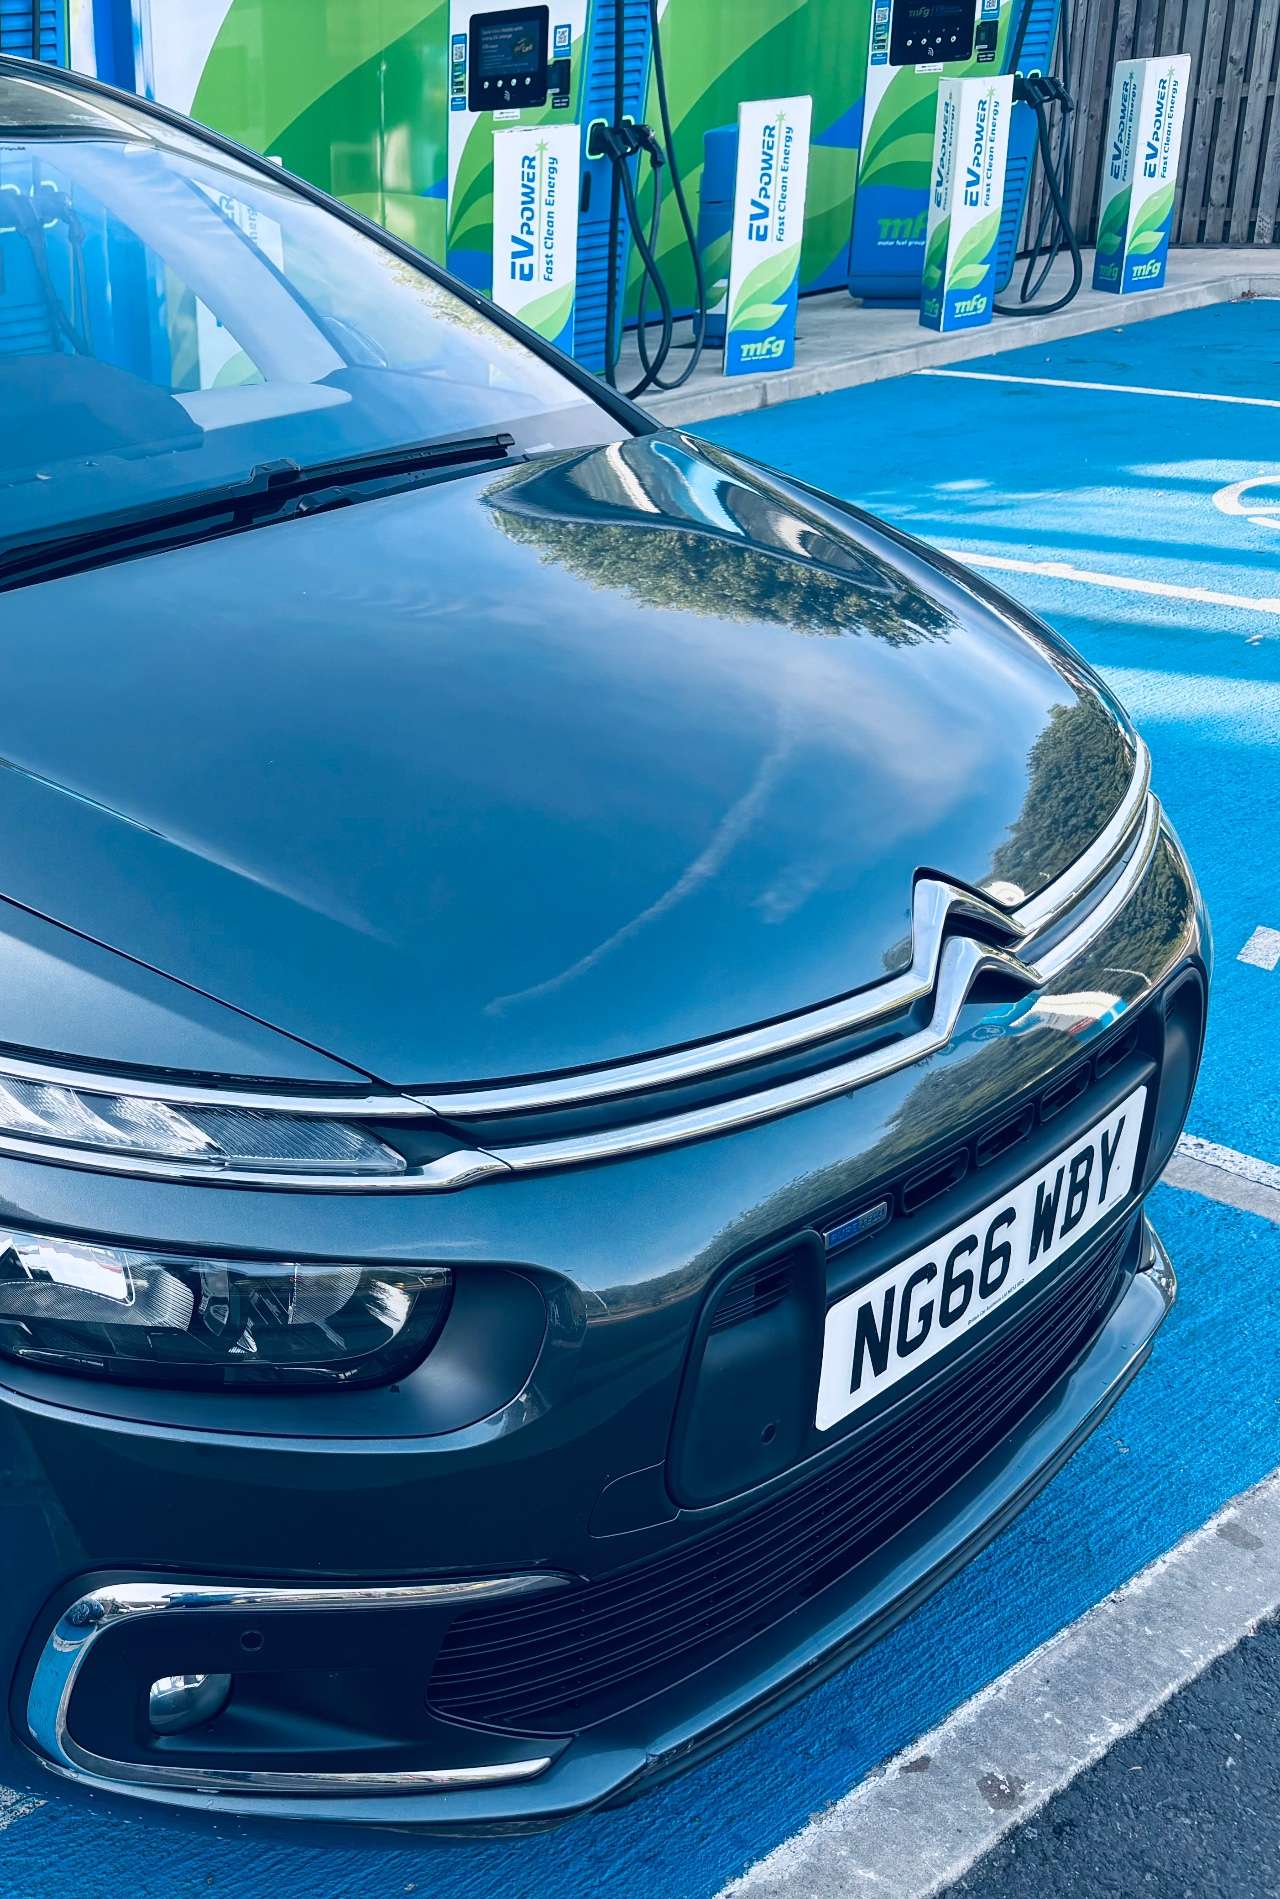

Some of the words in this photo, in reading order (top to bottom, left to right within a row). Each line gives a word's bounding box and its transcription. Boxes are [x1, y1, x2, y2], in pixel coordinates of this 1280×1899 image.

[1167, 80, 1179, 119] Energy
[988, 100, 1000, 142] Energy
[780, 126, 794, 172] Energy
[1163, 122, 1172, 153] Clean
[986, 146, 994, 179] Clean
[1160, 158, 1168, 178] Fast
[545, 156, 559, 206] Energy
[777, 176, 789, 213] Clean
[983, 182, 991, 207] Fast
[544, 211, 555, 250] Clean
[776, 216, 785, 242] Fast
[877, 211, 928, 240] mf
[544, 254, 553, 282] Fast
[1132, 259, 1162, 278] mfg
[954, 293, 987, 314] mfg
[740, 336, 786, 358] mfg
[850, 1206, 1016, 1395] NG66
[1029, 1114, 1127, 1265] WBY
